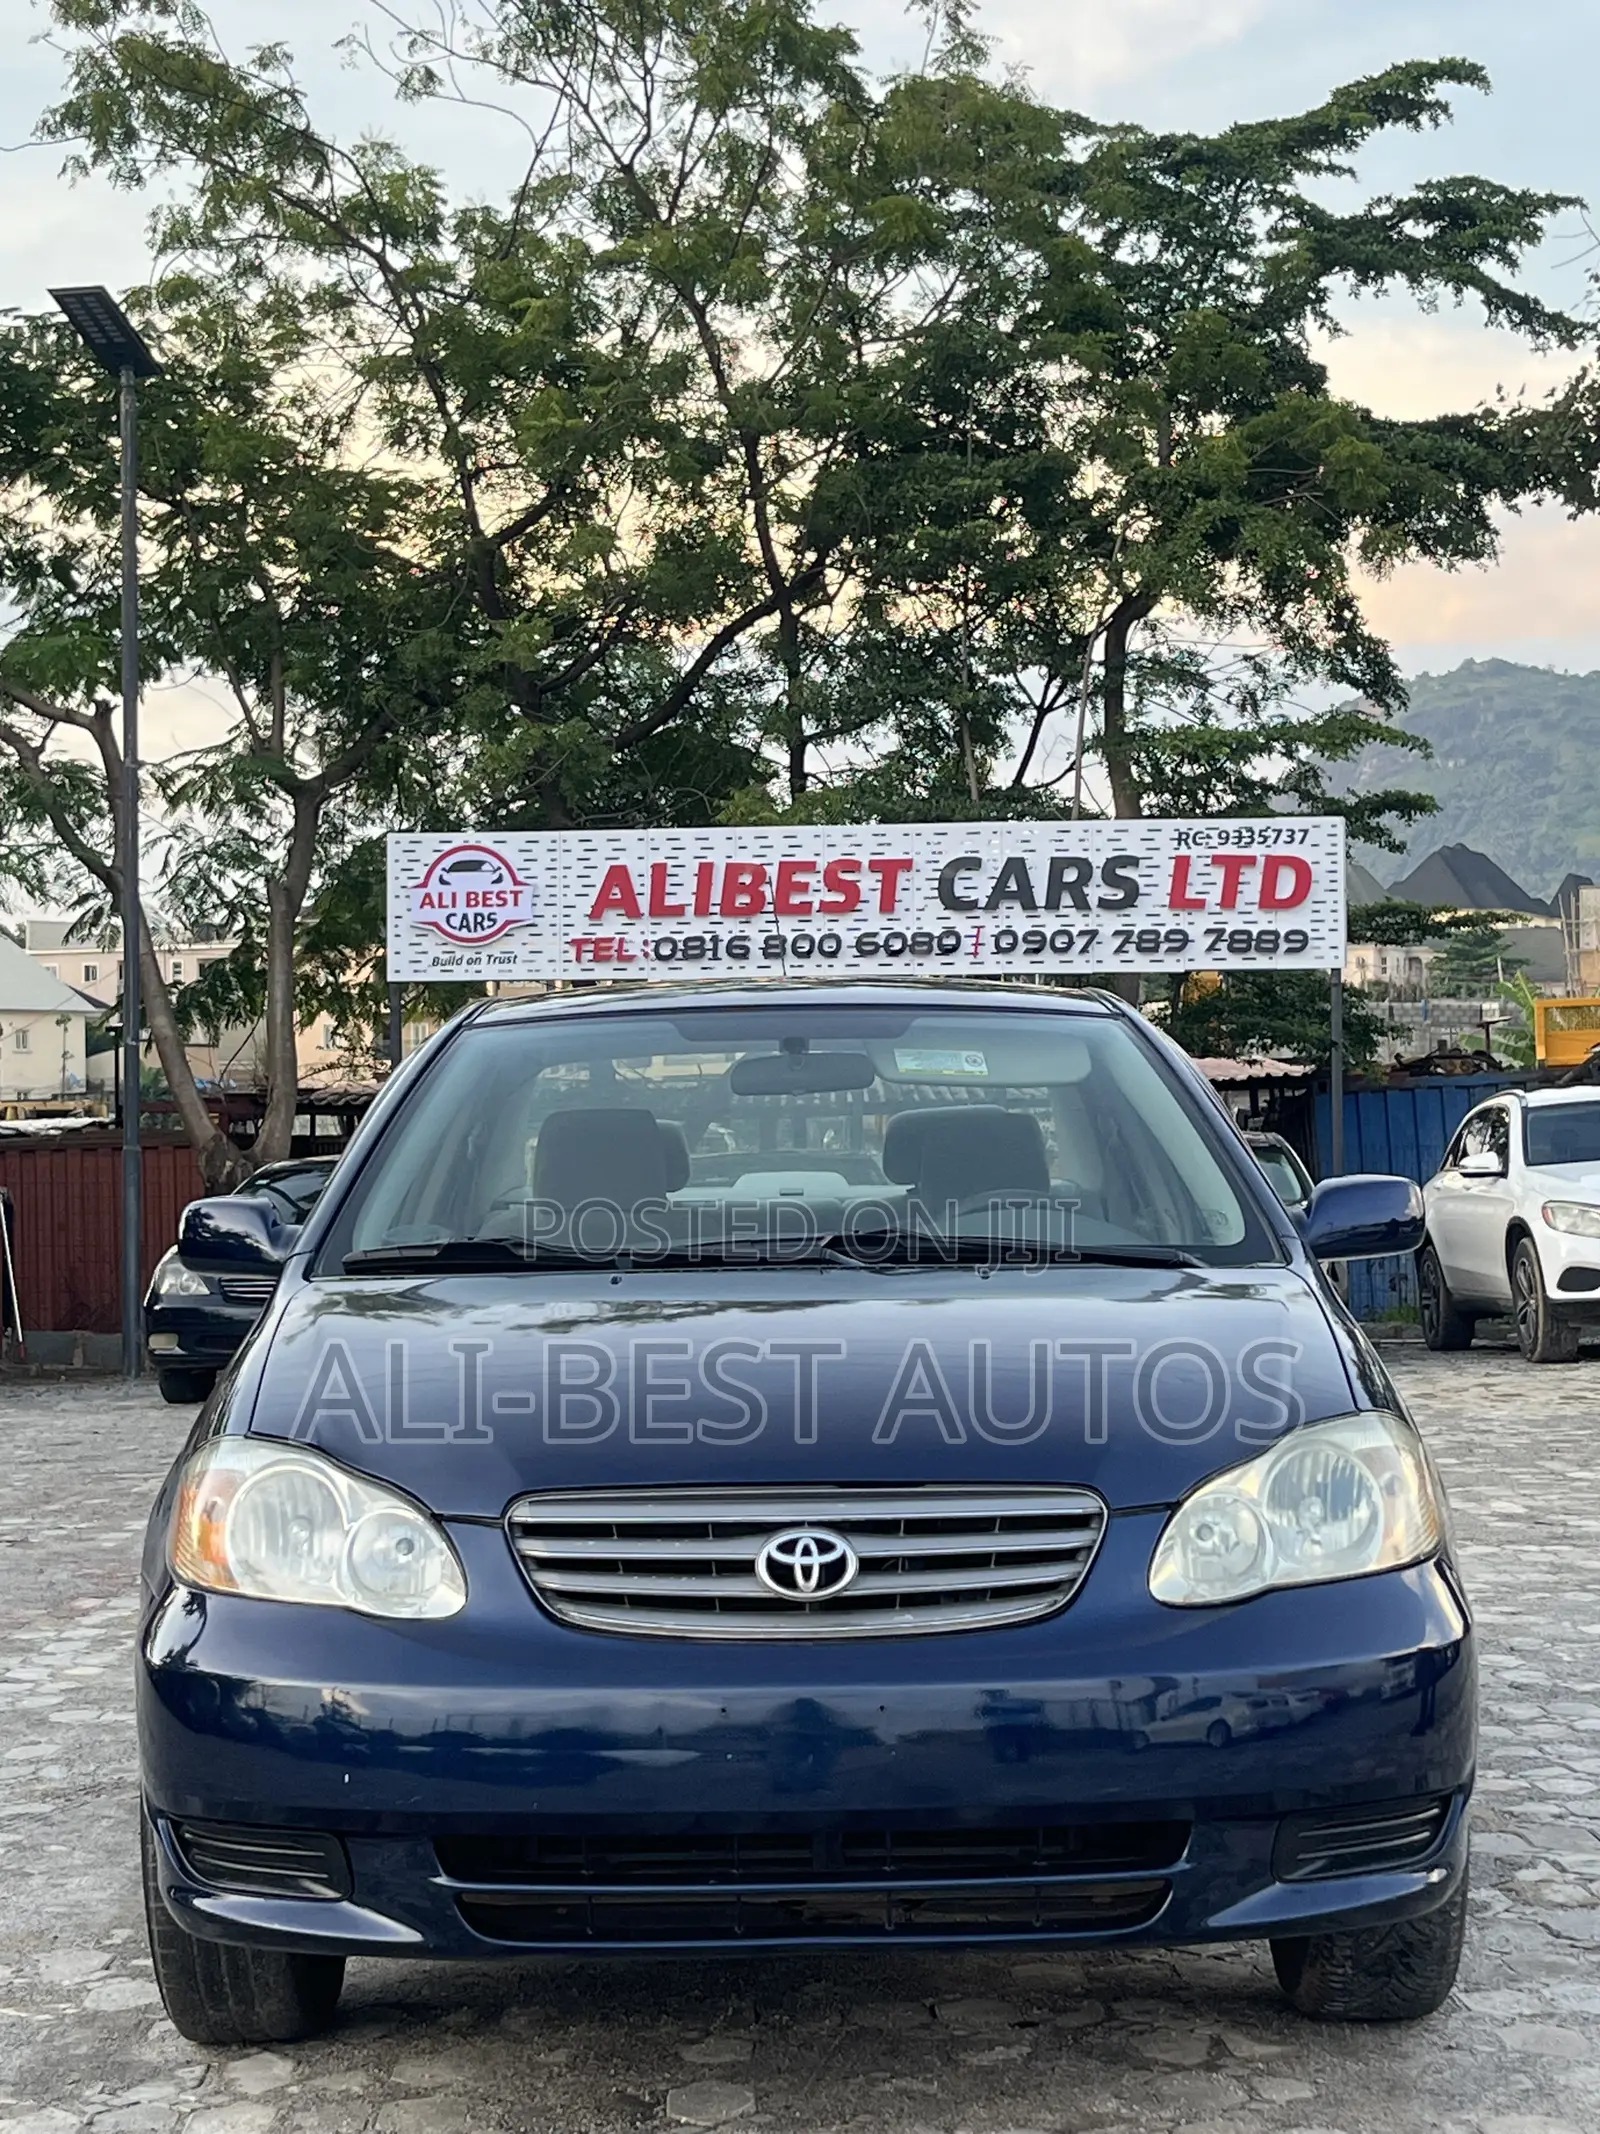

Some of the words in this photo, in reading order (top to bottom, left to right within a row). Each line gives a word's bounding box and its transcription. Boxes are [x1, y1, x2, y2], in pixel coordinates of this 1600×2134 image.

[1217, 828, 1310, 846] 9335737
[589, 857, 914, 920] ALIBEST
[937, 854, 1141, 912] CARS
[1168, 854, 1313, 910] LTD
[420, 891, 457, 909] ALI
[466, 890, 523, 909] BEST
[445, 912, 498, 933] CARS
[762, 934, 842, 959] 800
[855, 929, 962, 957] 6080
[994, 927, 1099, 955] 0907
[1111, 928, 1189, 954] 789
[1203, 927, 1310, 954] 7889
[431, 954, 464, 967] Build
[466, 956, 482, 966] on
[486, 953, 518, 966] Trust
